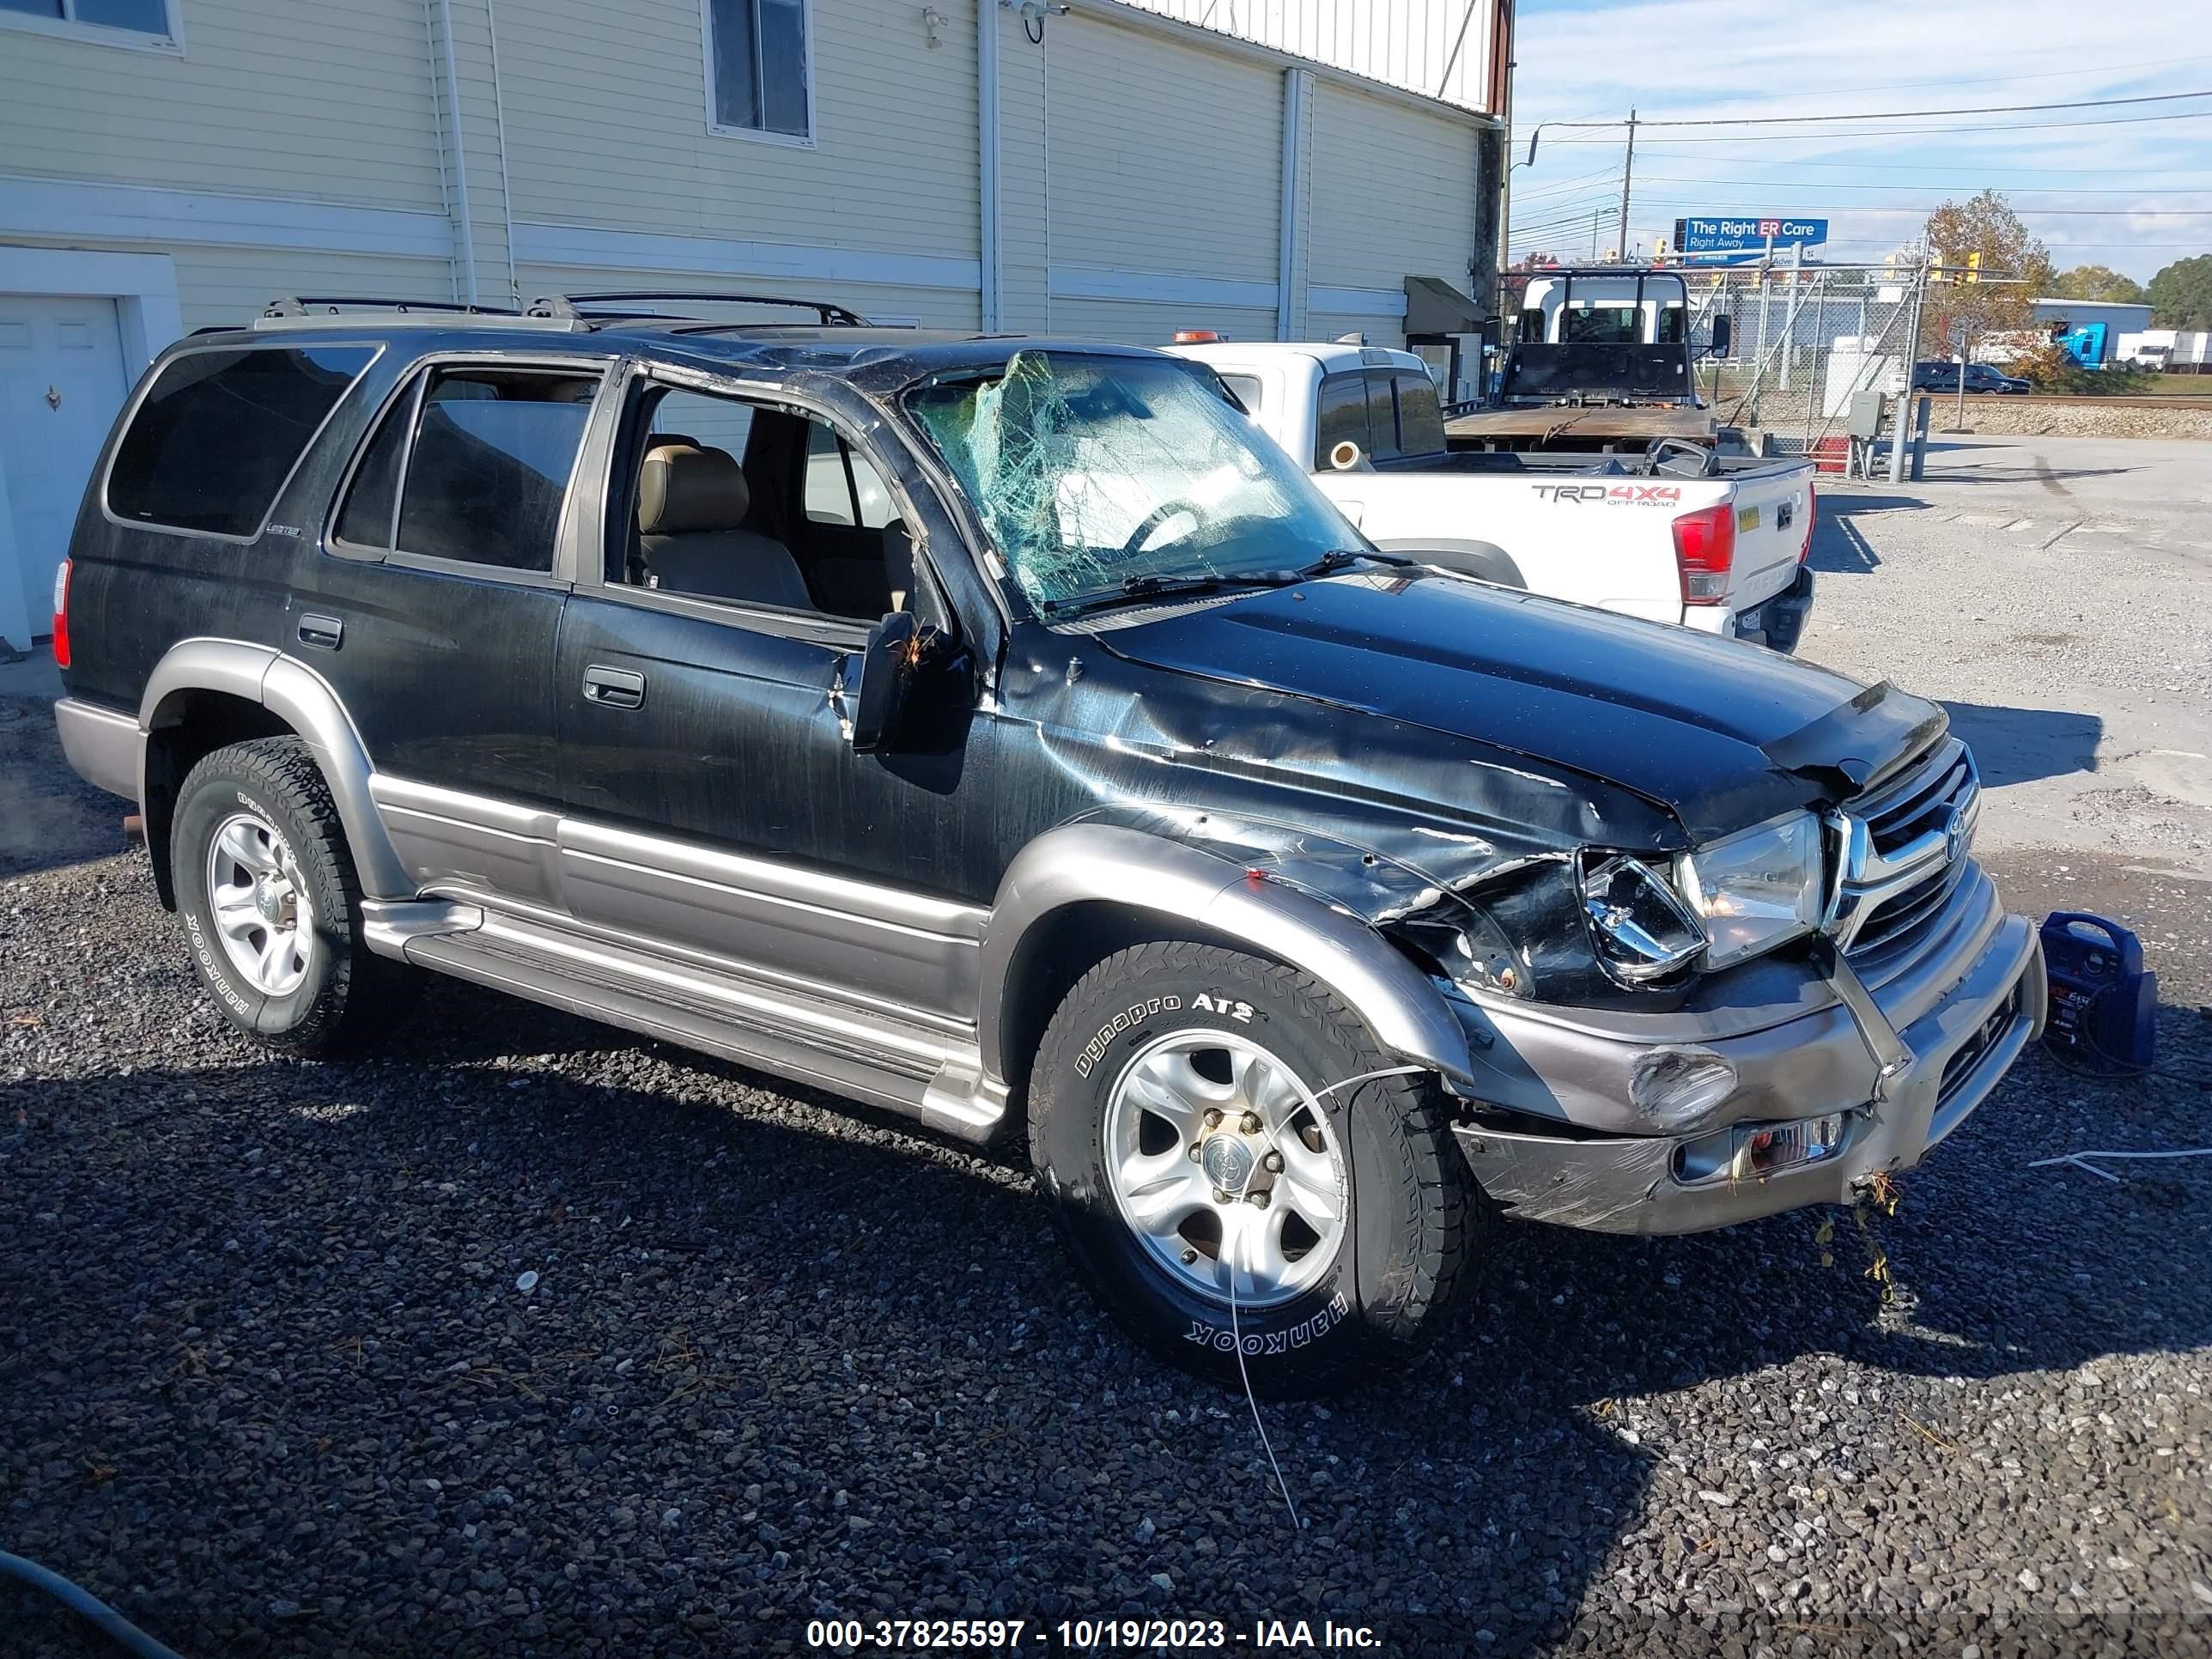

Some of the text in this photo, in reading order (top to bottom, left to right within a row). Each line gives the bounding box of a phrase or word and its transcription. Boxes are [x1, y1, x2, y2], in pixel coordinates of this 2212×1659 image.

[1691, 221, 1814, 236] The Right ER Care
[1690, 237, 1745, 249] Right Away
[1532, 485, 1607, 504] TRD
[1074, 995, 1182, 1079] Dynapro
